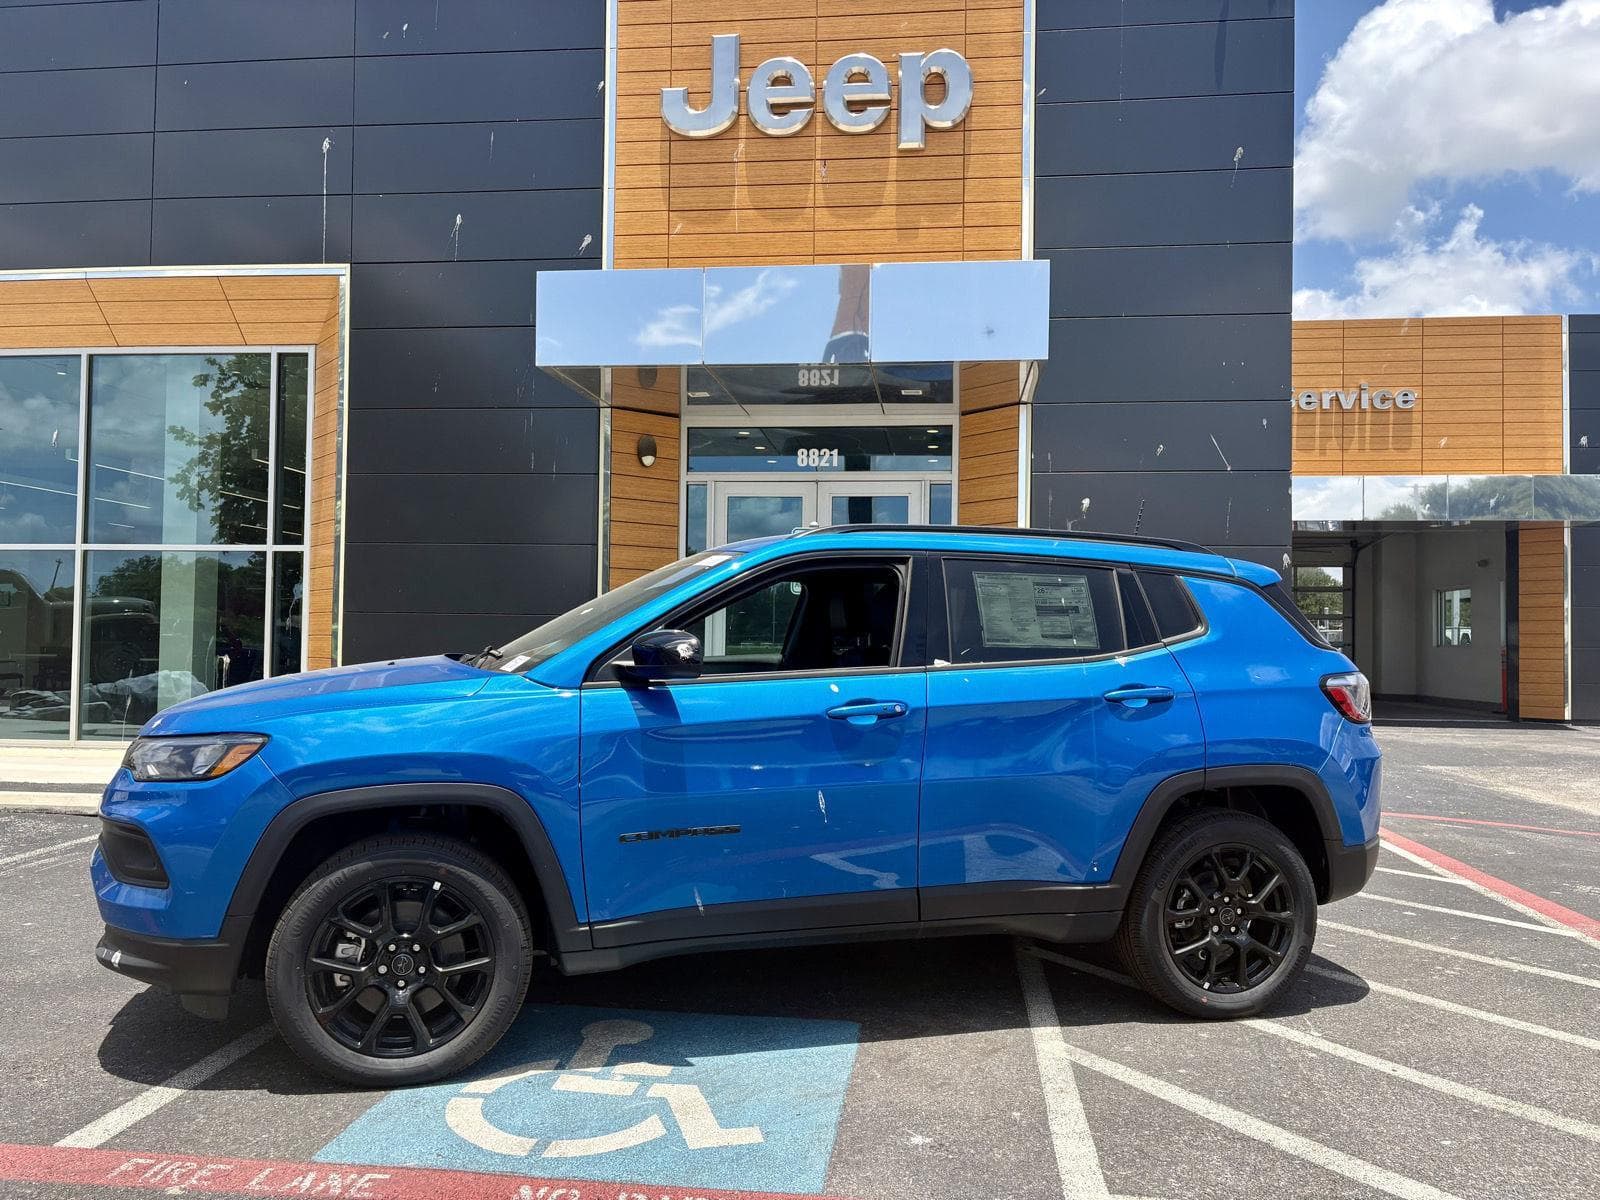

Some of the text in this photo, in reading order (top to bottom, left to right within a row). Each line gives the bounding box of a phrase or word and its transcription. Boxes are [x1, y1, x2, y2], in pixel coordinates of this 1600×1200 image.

[660, 34, 974, 150] Jeep
[1292, 383, 1416, 411] ervice
[797, 448, 839, 467] 8821
[106, 1157, 234, 1187] FIRE
[246, 1167, 392, 1198] LANE
